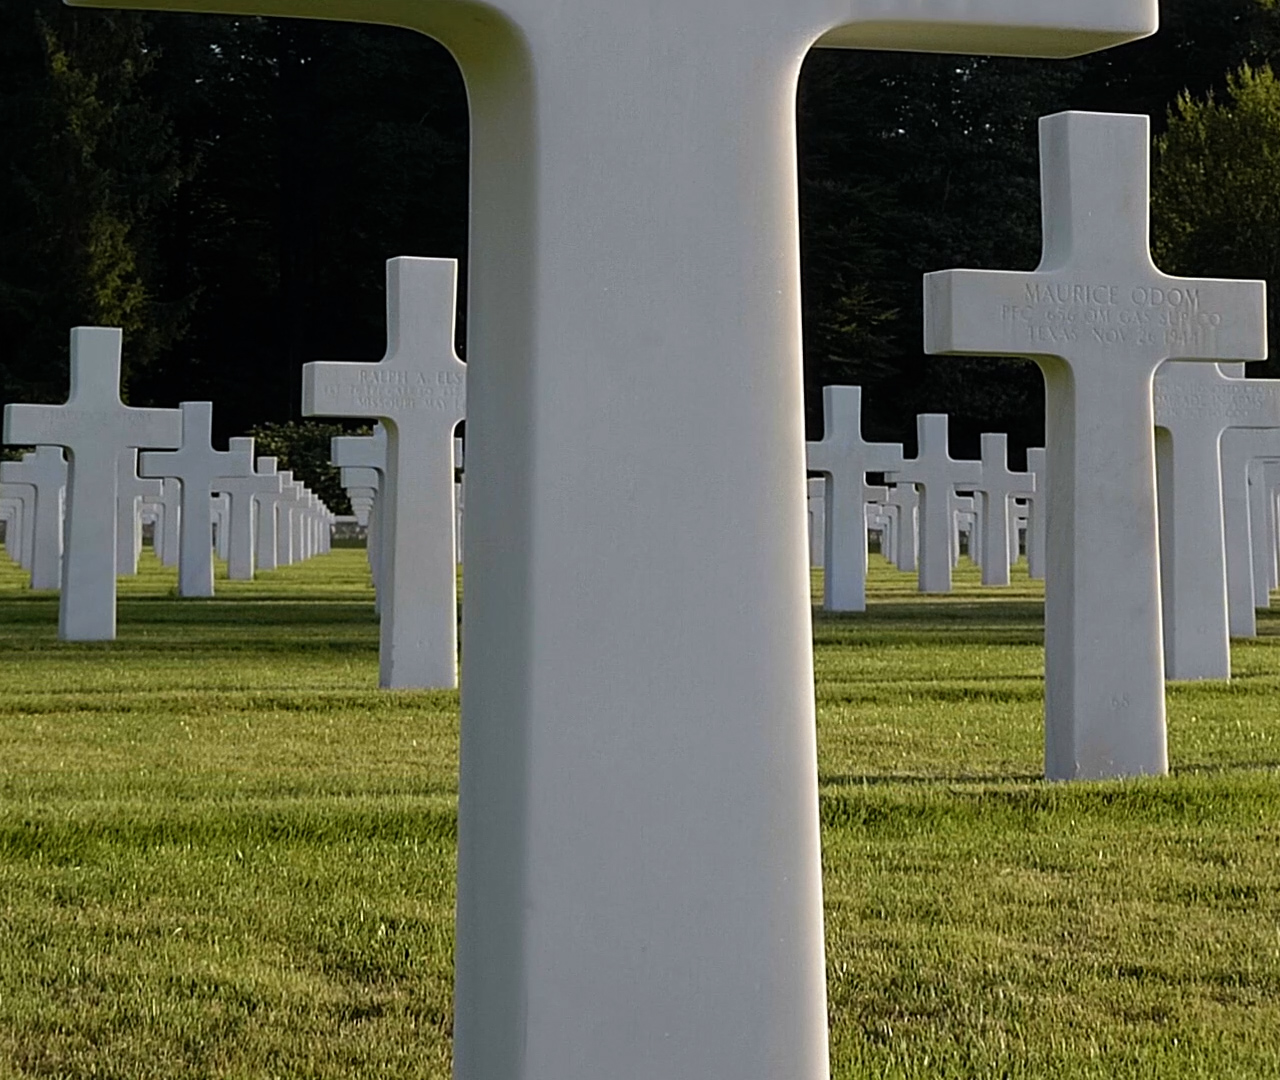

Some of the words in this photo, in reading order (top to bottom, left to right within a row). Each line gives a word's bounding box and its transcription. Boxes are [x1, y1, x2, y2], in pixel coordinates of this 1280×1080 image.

[1025, 283, 1119, 305] MAURICE
[1131, 286, 1200, 308] ODOM
[1000, 304, 1033, 321] PFC
[1119, 309, 1152, 325] GAS
[1028, 325, 1078, 342] TEXAS
[1091, 327, 1126, 343] NOV
[359, 370, 408, 385] RALPH
